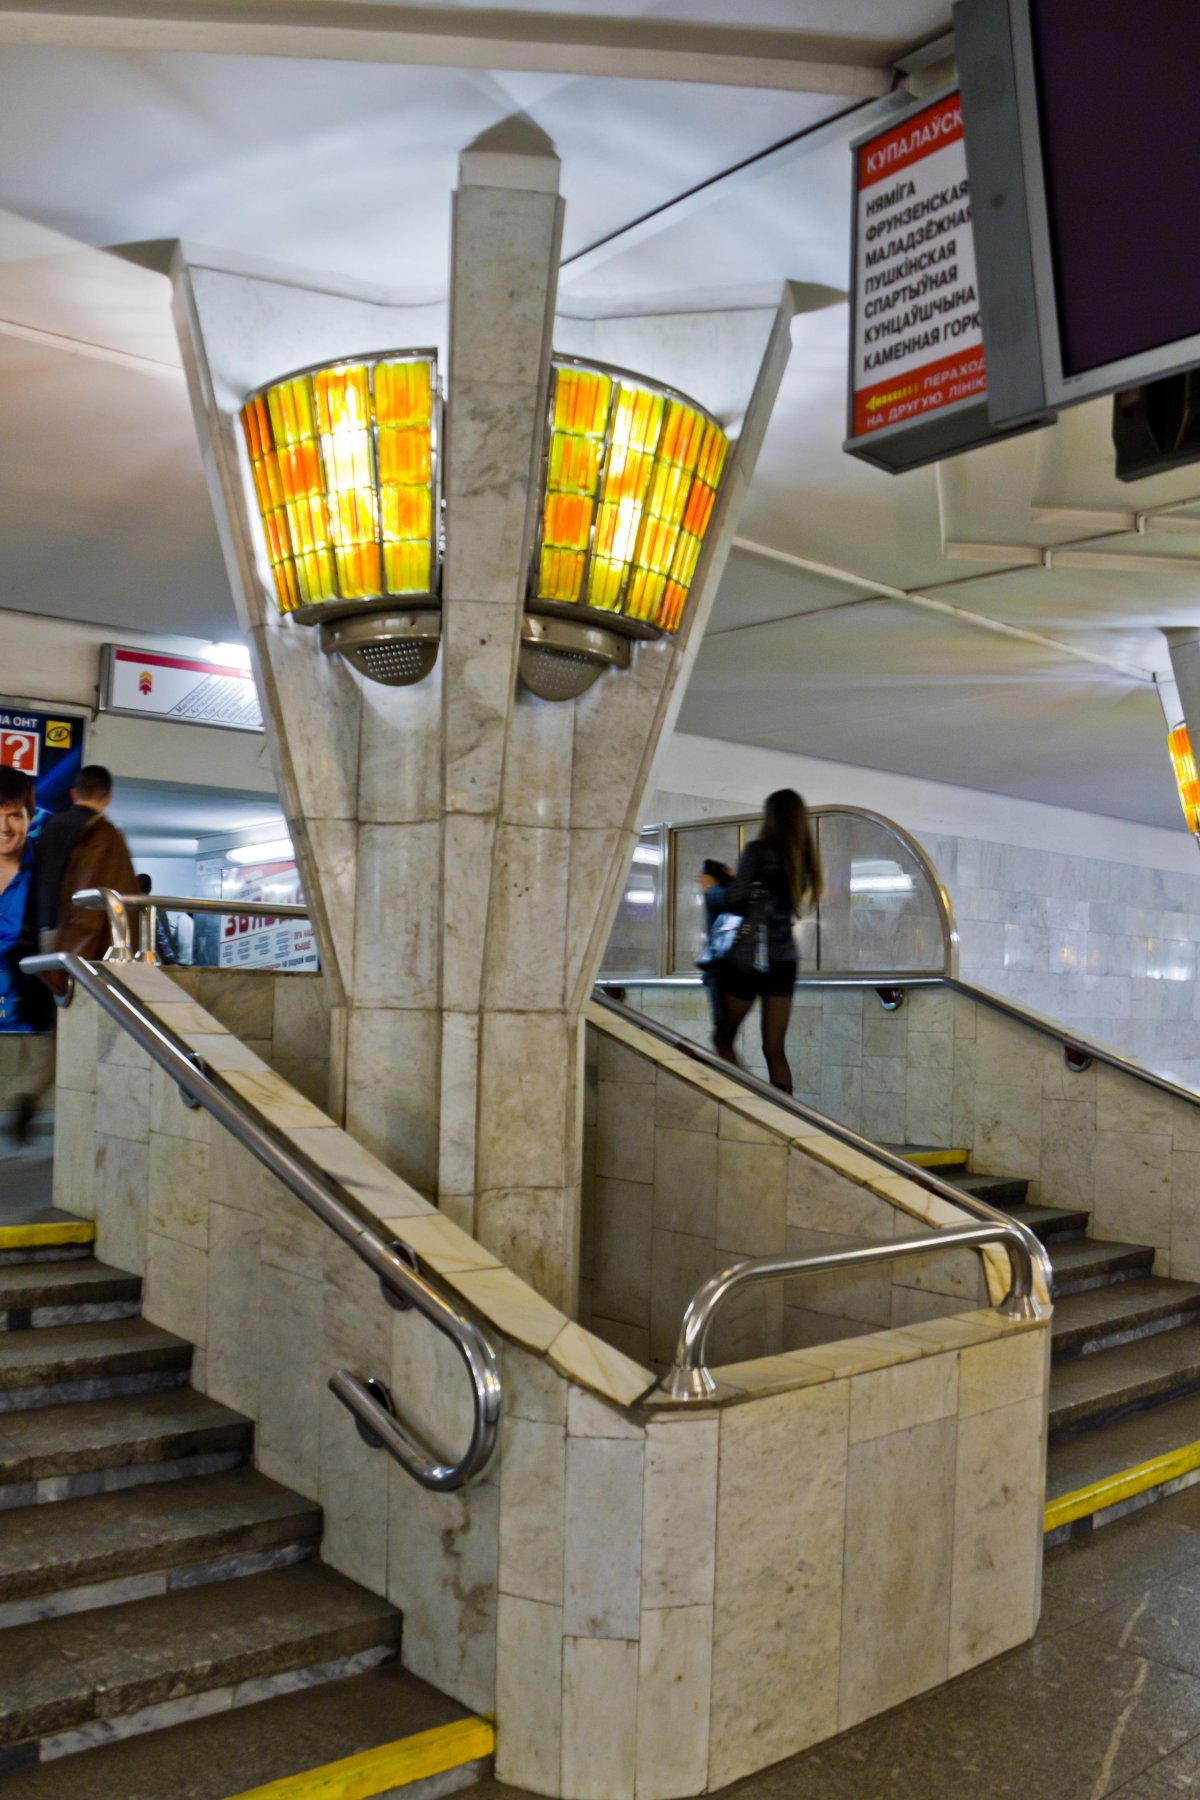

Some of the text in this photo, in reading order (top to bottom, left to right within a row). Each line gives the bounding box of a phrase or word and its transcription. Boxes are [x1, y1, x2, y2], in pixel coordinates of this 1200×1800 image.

[865, 179, 969, 242] ФРУНЗЕНСКАЯ
[866, 180, 916, 217] НЯМІГА
[864, 264, 958, 319] СПАРТЫЎНАЯ
[865, 239, 956, 294] ПУШКІНСКАЯ
[864, 284, 976, 344] КУНЦАЎШЧЫНА
[863, 325, 940, 372] КАМЕННАЯ
[866, 412, 884, 428] НА
[888, 391, 943, 421] ДРУГУЮ
[13, 716, 39, 728] ОНТ
